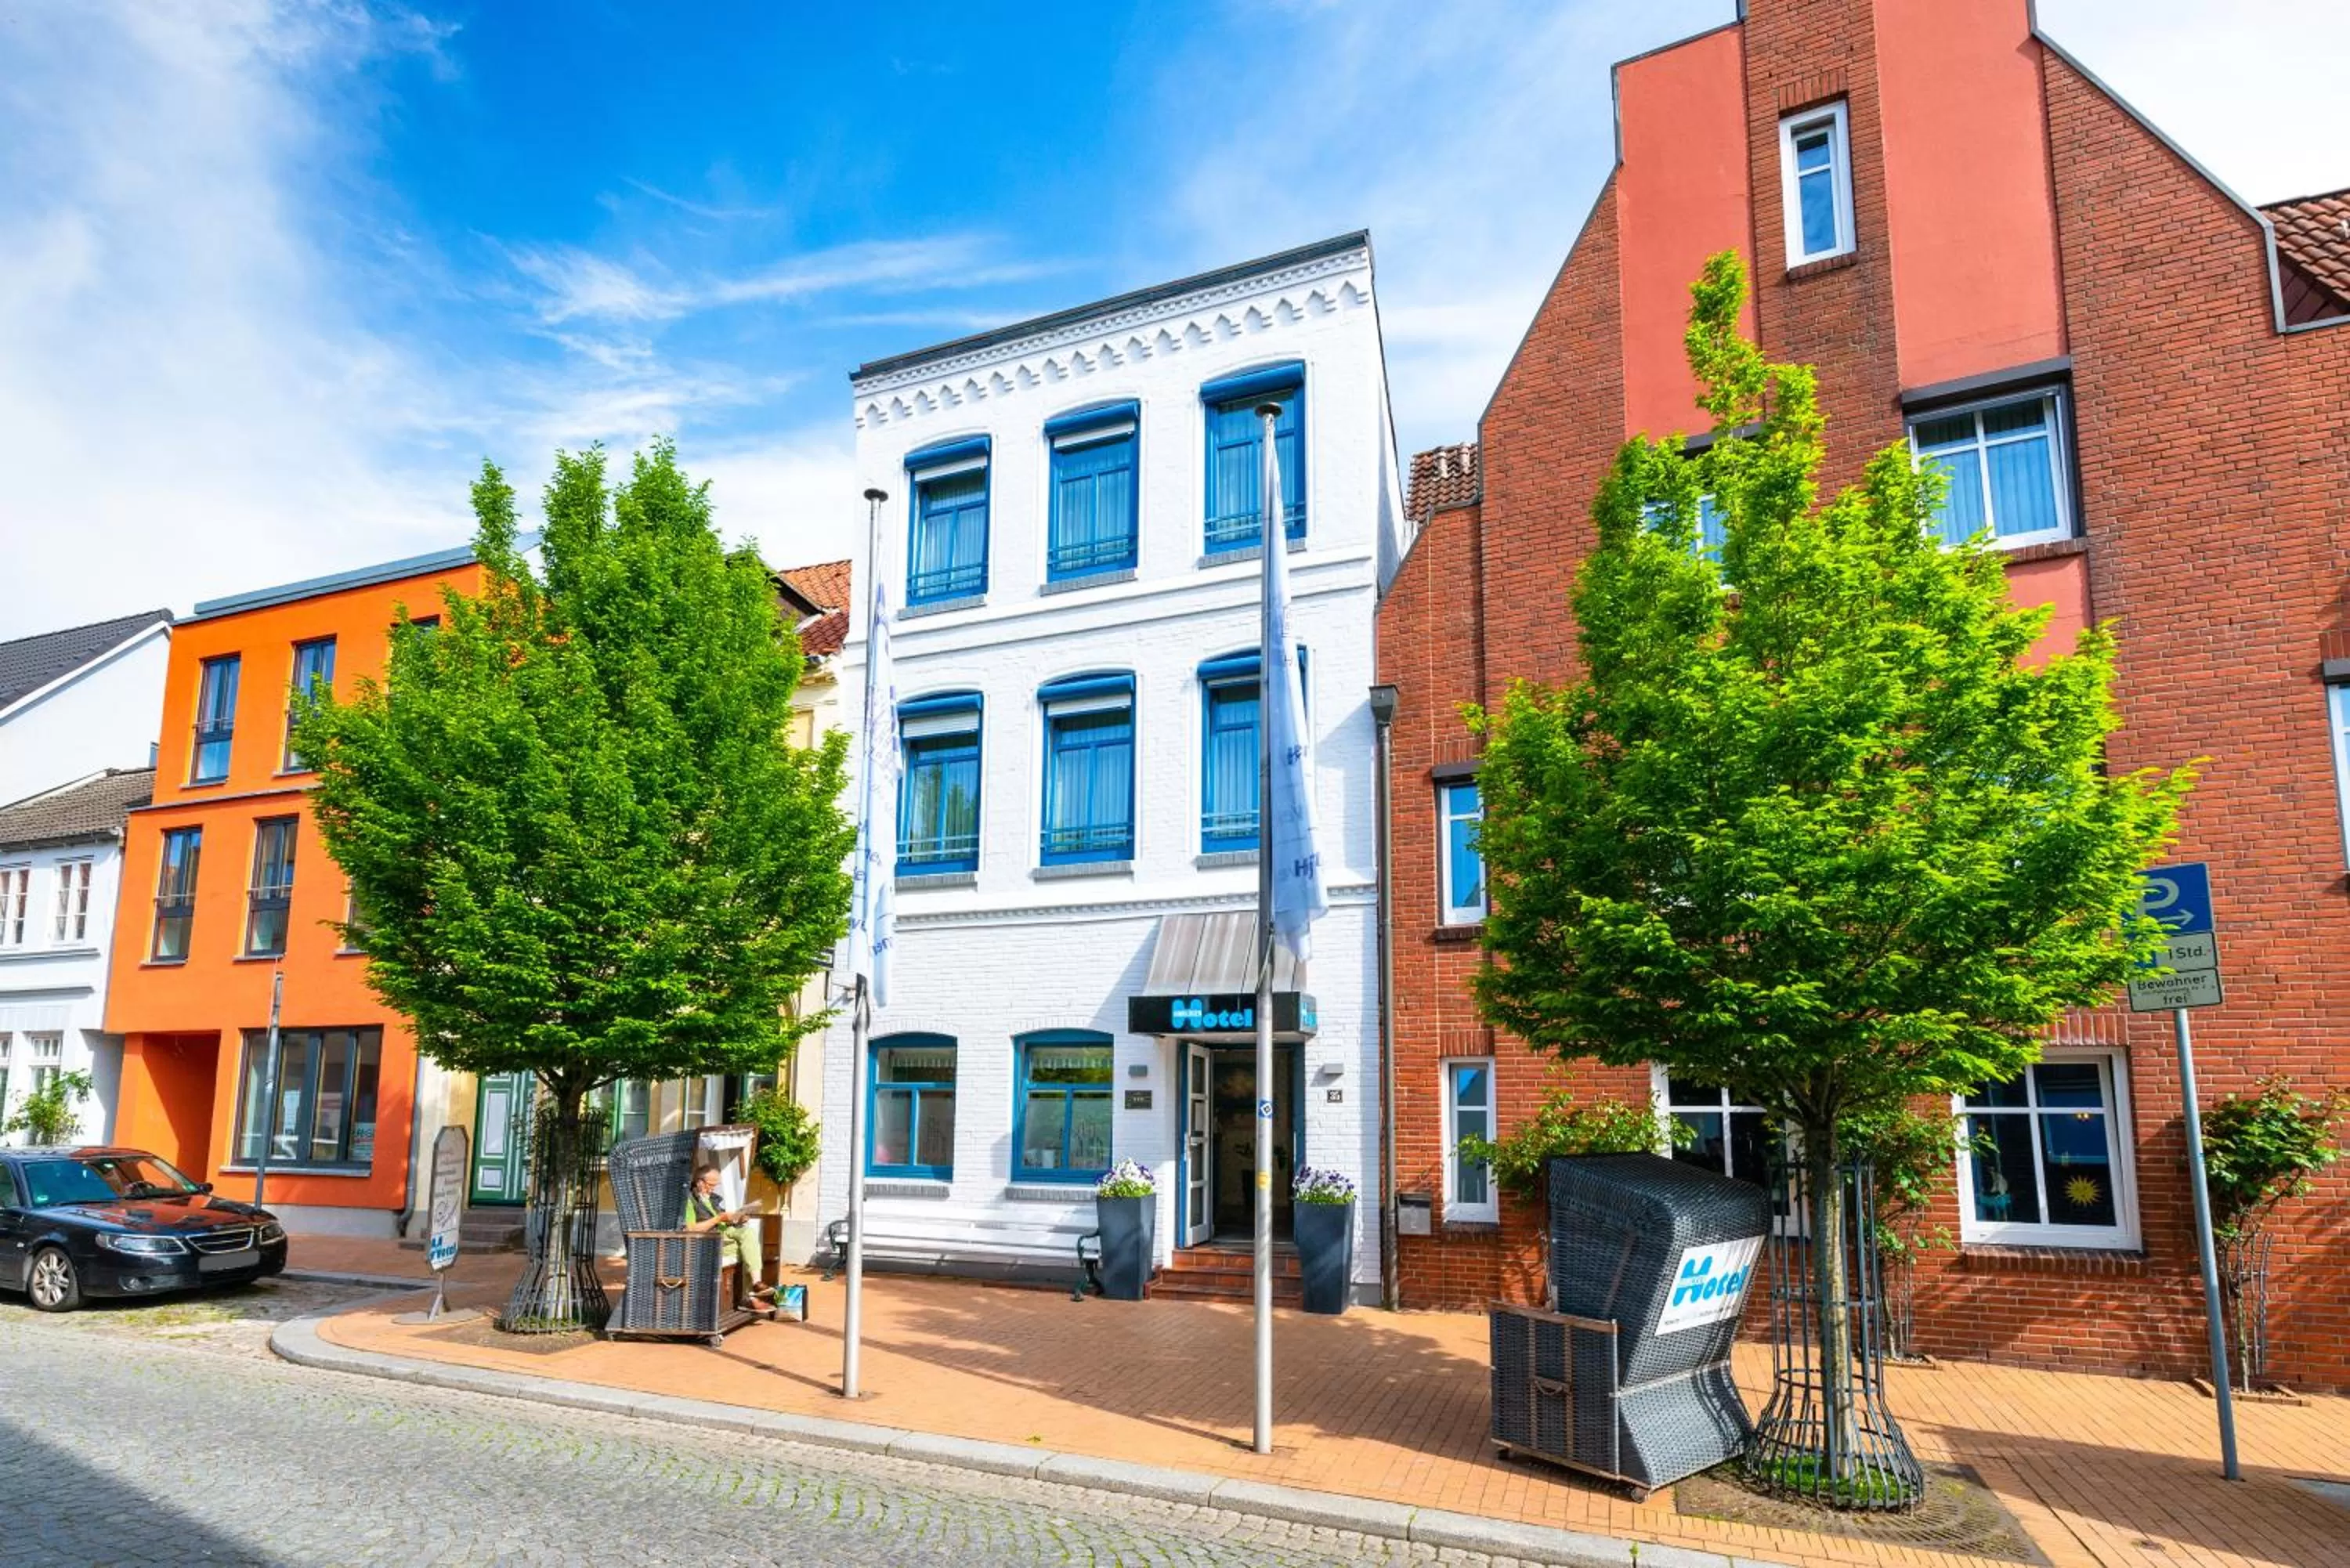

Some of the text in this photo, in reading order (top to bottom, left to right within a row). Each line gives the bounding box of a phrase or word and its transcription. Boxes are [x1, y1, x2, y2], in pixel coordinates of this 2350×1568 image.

[2135, 877, 2180, 918] P
[2175, 945, 2206, 959] Std.
[2137, 974, 2208, 991] Bewohner
[2162, 994, 2188, 1005] frei
[1171, 998, 1253, 1030] Hotel
[1673, 1255, 1750, 1306] Hotel
